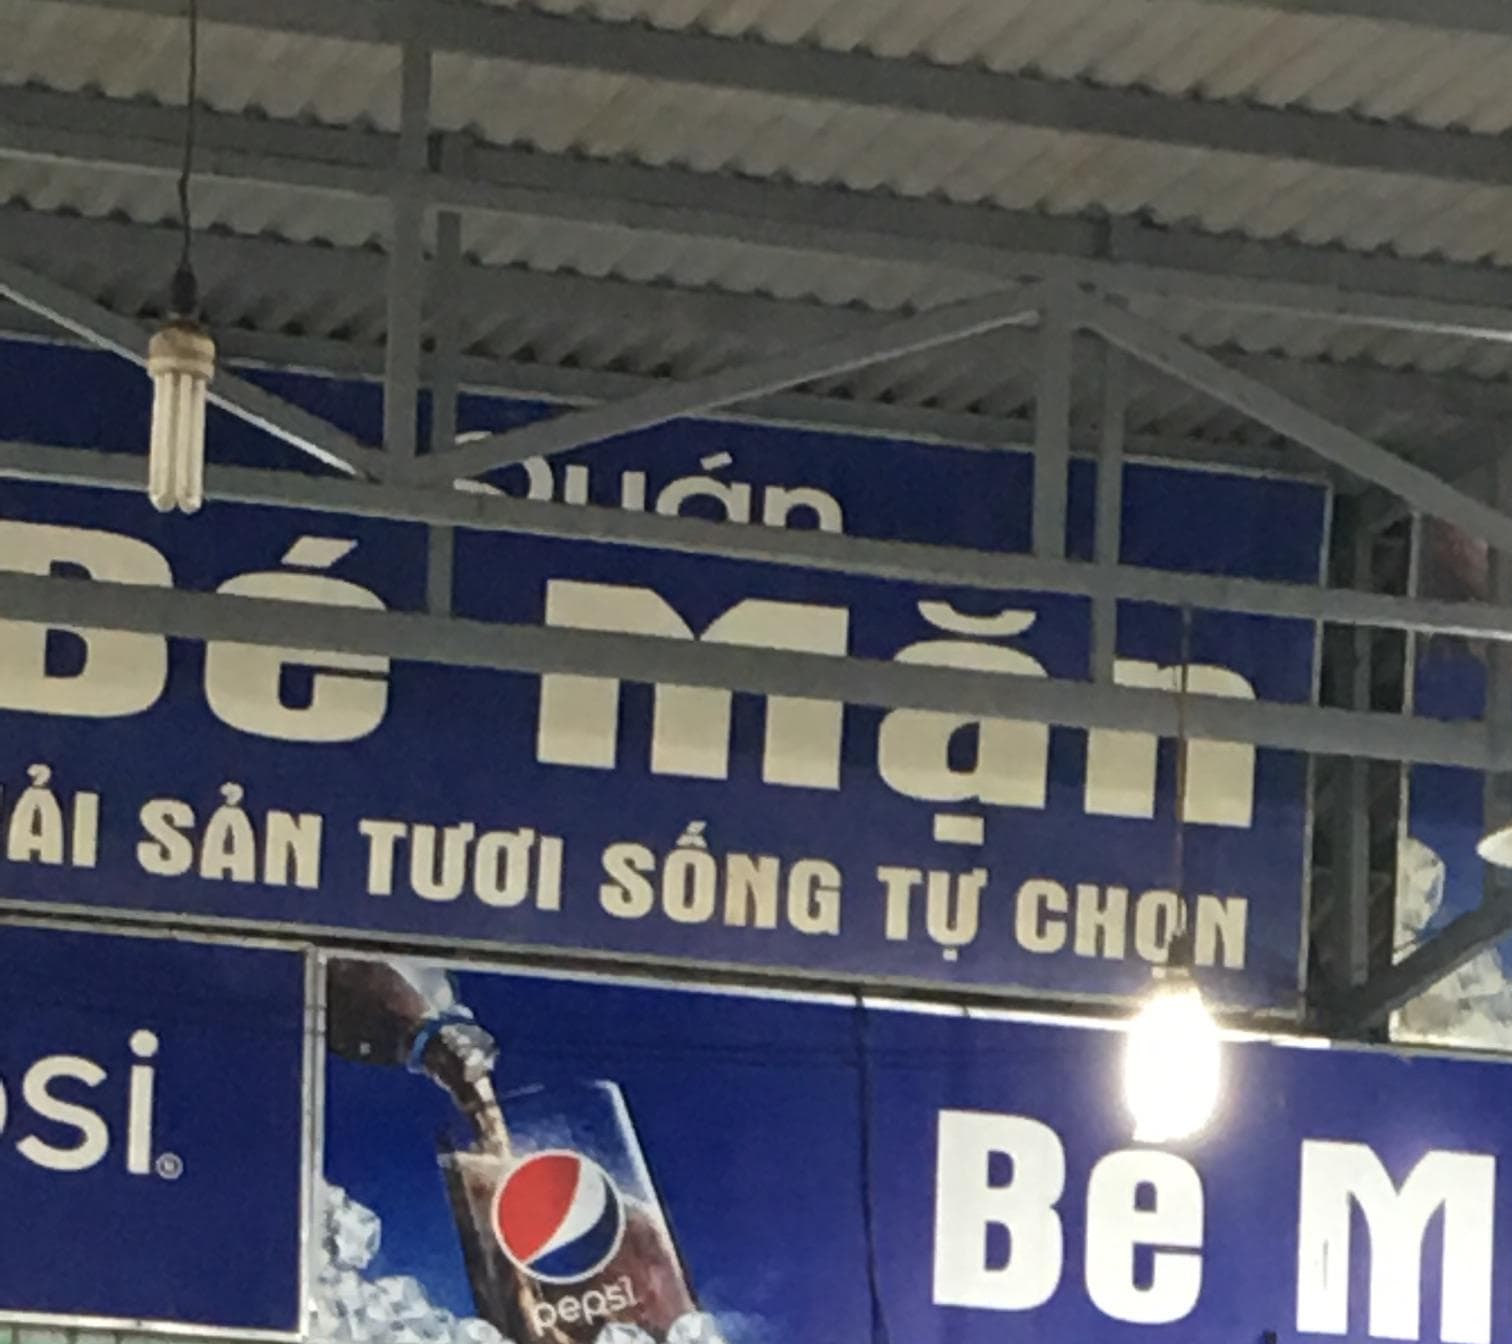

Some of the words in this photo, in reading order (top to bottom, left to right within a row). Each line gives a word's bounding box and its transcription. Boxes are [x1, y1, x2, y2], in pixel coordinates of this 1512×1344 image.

[0, 518, 391, 743] Bé
[537, 578, 1256, 845] Mặn
[0, 763, 98, 868] ẢI
[137, 782, 323, 889] SẢN
[359, 818, 564, 911] TƯƠI
[600, 821, 842, 936] SỐNG
[878, 865, 988, 962] TỰ
[1015, 879, 1248, 977] CHỌN
[0, 1029, 159, 1174] si
[530, 1276, 638, 1337] pepsi
